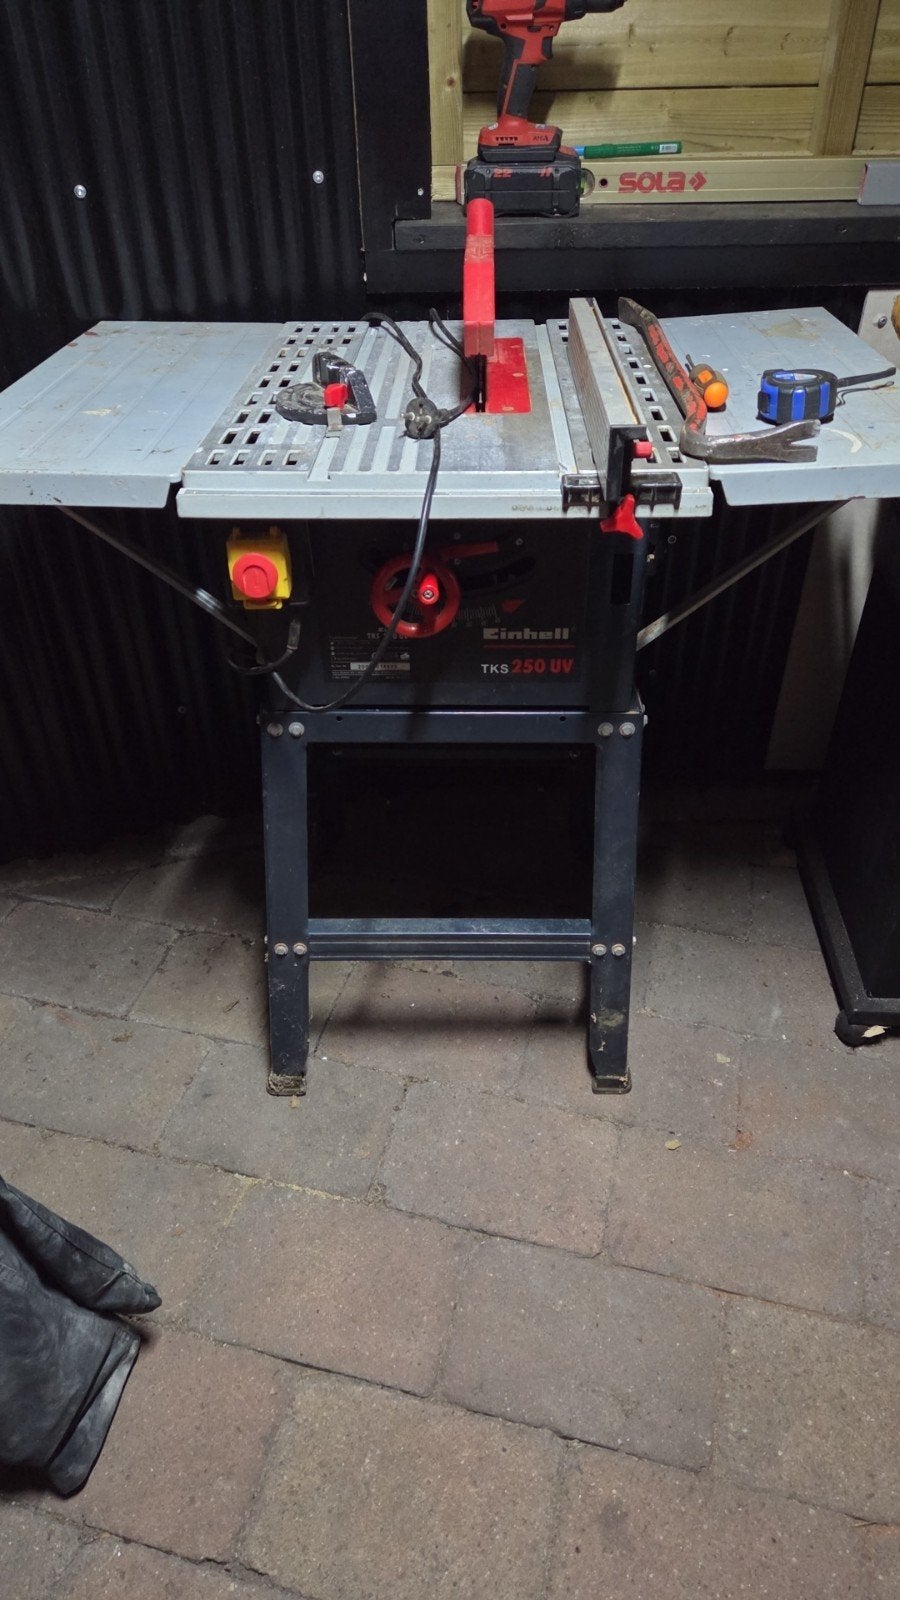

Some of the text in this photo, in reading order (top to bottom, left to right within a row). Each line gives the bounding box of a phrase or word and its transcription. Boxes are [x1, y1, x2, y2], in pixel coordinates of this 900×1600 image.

[482, 627, 570, 640] Einhell
[481, 657, 574, 674] TKS 250 UV
